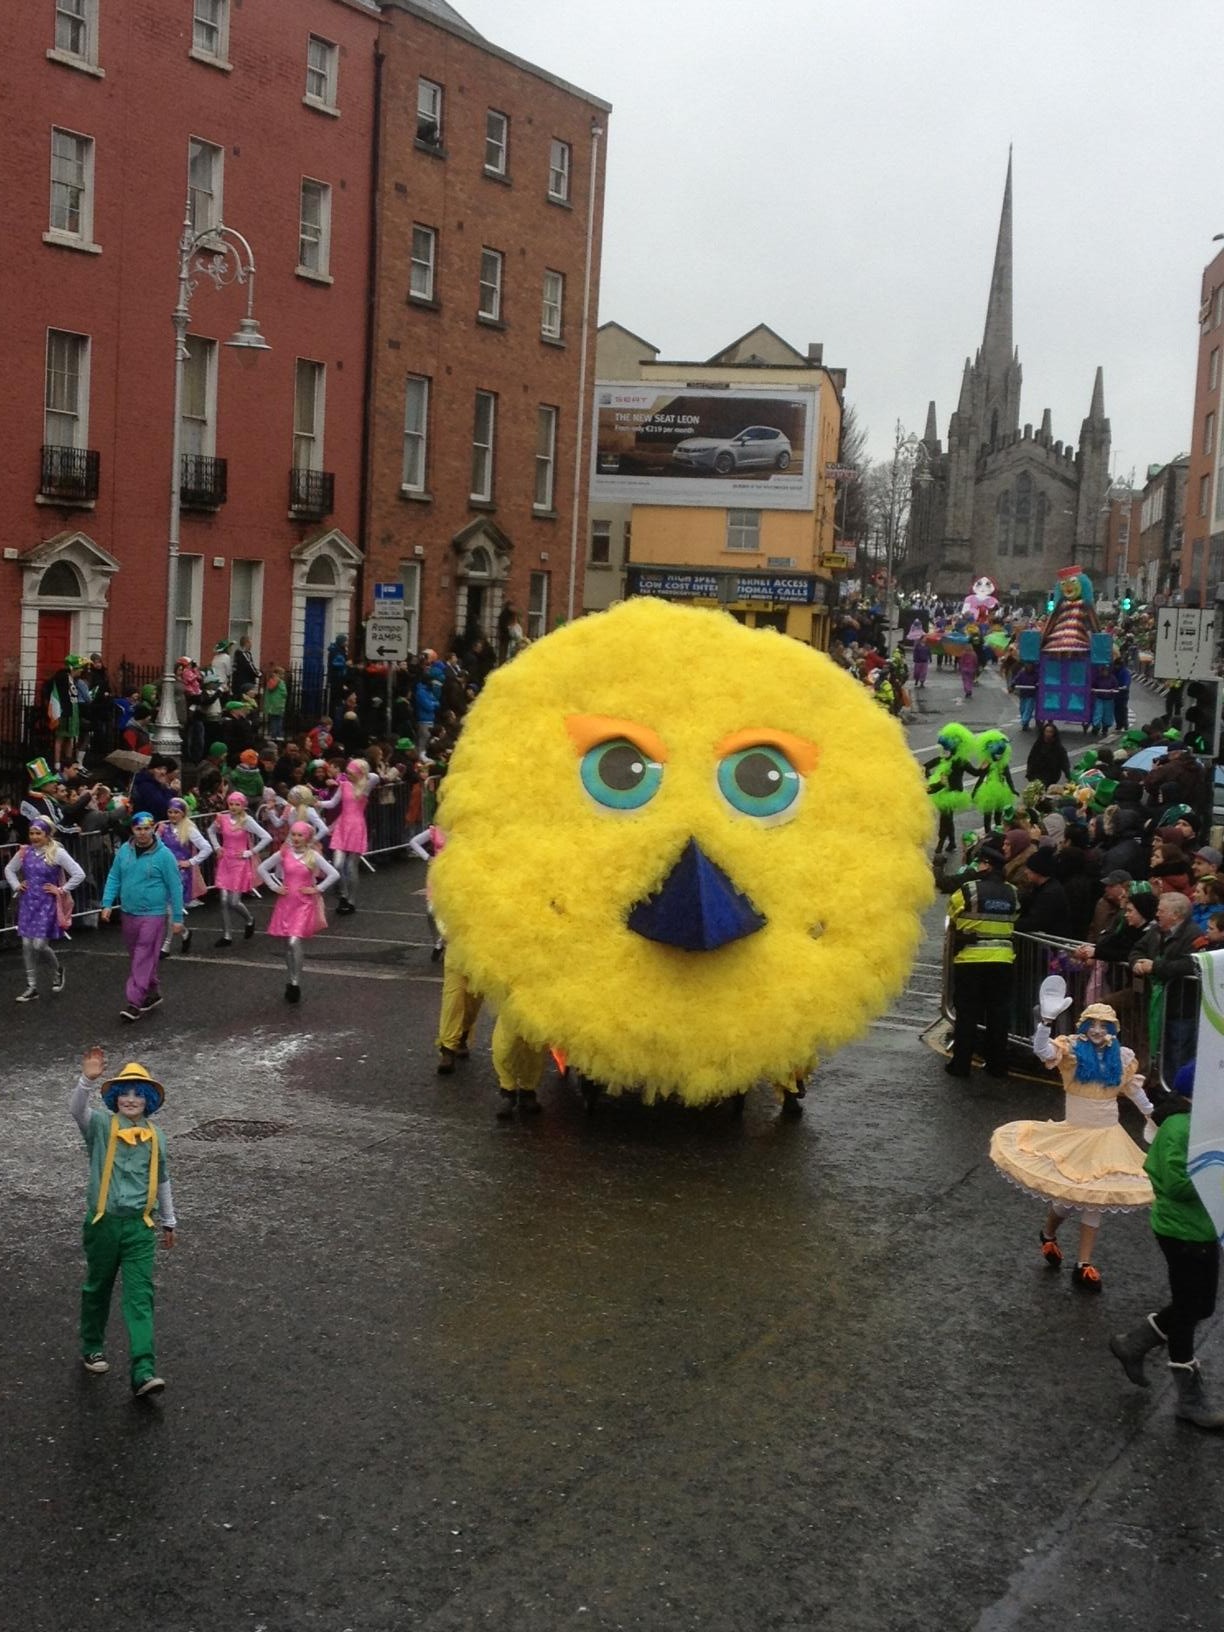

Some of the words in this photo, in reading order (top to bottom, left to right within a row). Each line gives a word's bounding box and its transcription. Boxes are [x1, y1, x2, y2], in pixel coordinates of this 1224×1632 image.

[615, 413, 631, 422] THE
[632, 414, 653, 423] NEW
[654, 414, 676, 424] SEAT
[677, 415, 700, 424] LEON
[645, 425, 662, 433] €219
[663, 426, 674, 434] per
[664, 582, 690, 590] COST
[773, 579, 809, 588] ACCESS
[776, 587, 809, 596] CALLS
[371, 633, 402, 641] RAMPS
